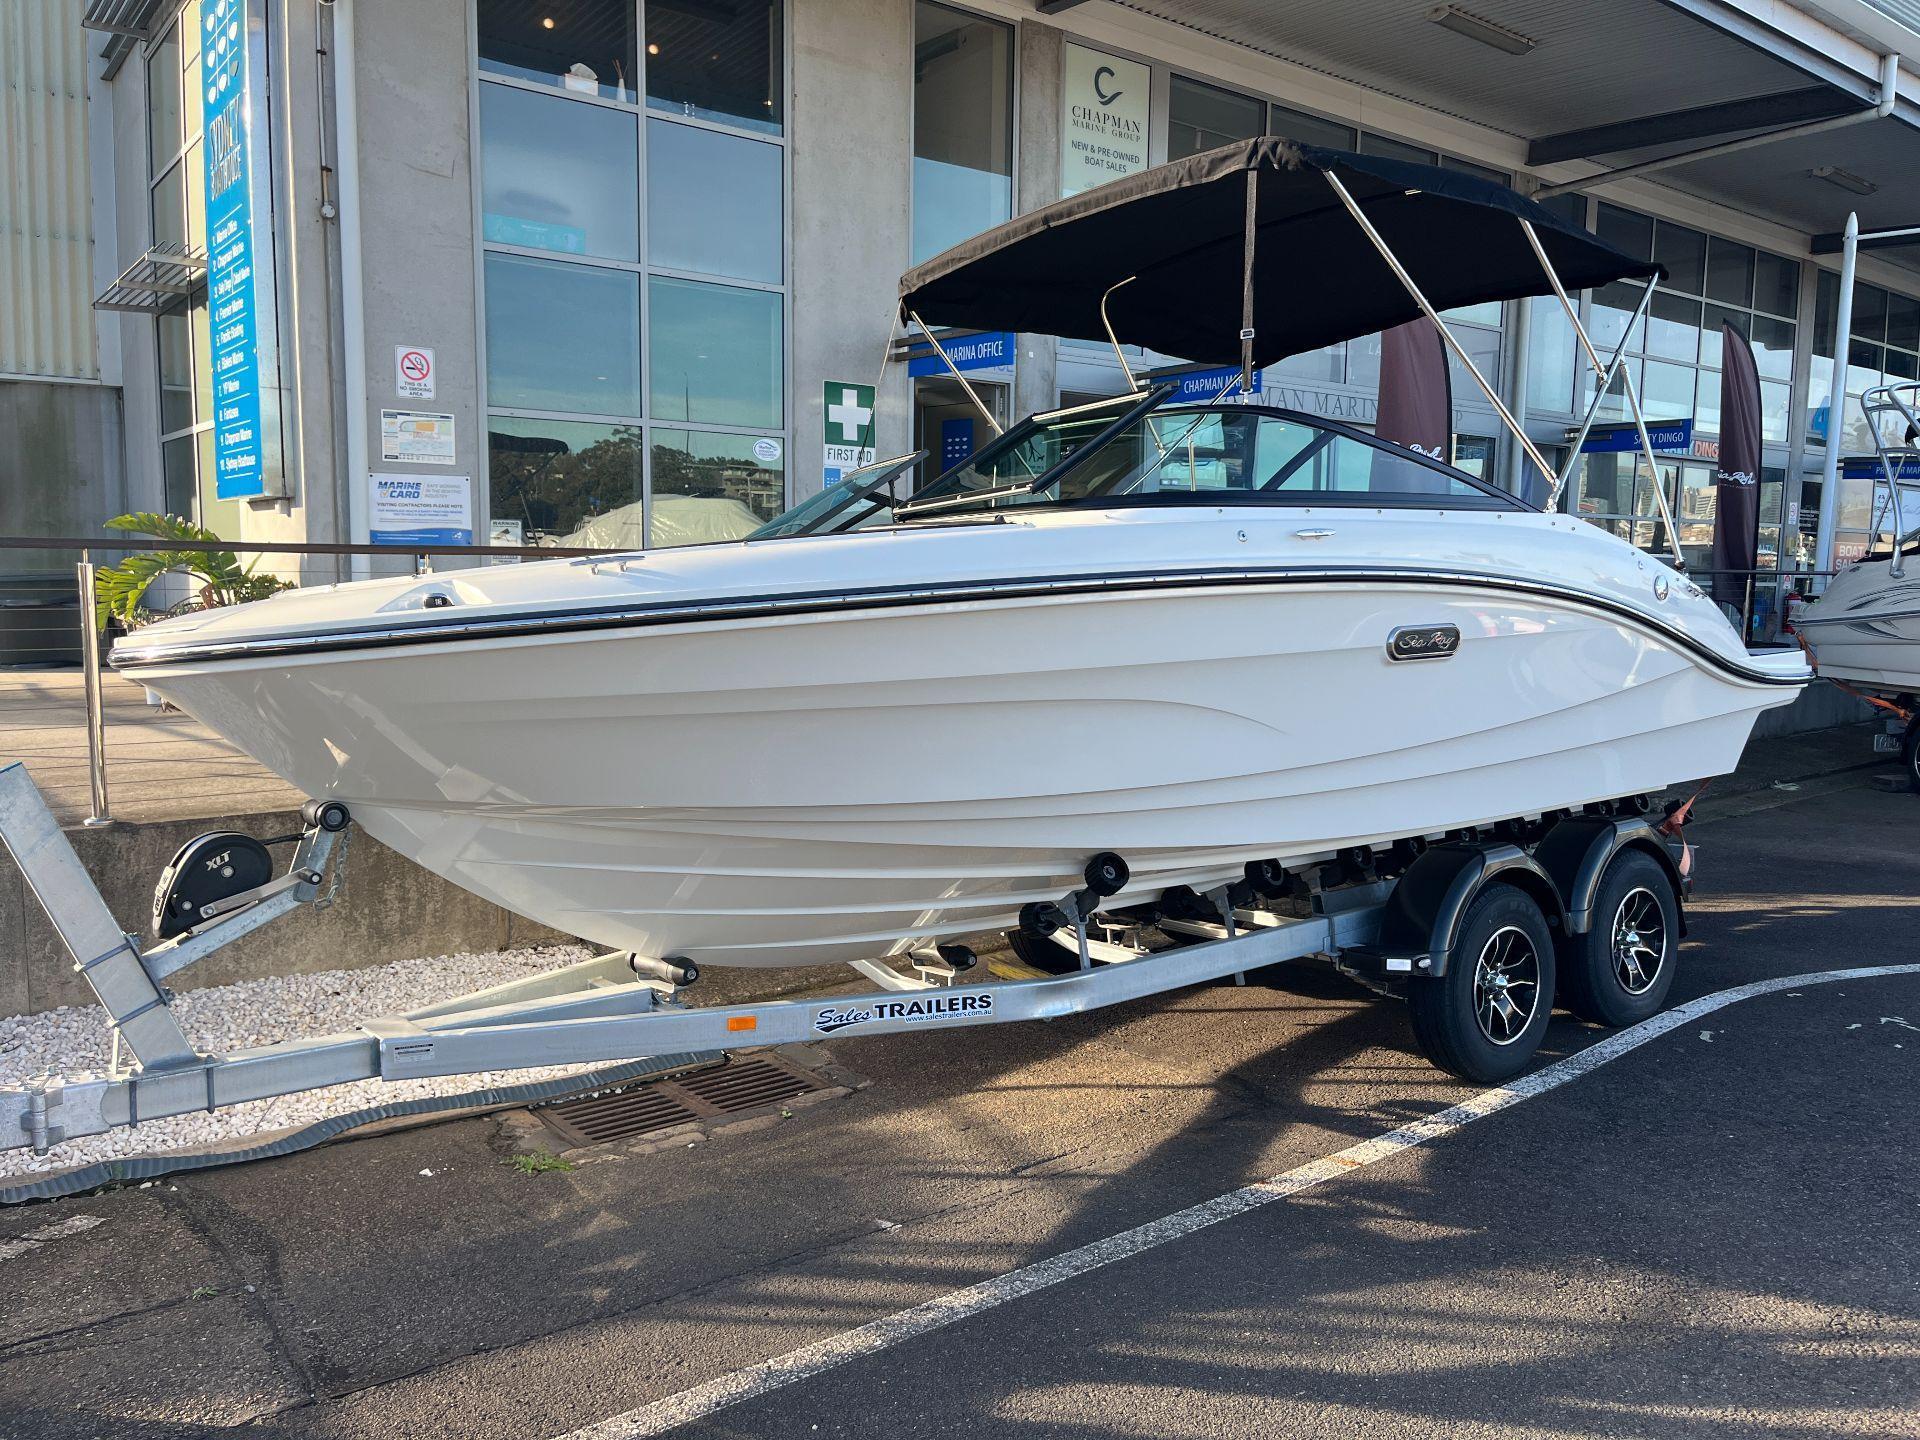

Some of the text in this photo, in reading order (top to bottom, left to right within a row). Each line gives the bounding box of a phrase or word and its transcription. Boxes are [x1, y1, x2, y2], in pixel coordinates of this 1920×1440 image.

[1072, 105, 1141, 133] CHAPMAN
[210, 93, 241, 170] SYDNEY
[1072, 118, 1141, 143] MARINE GROUP
[1071, 140, 1140, 164] NEW & PRE-OWNED
[1084, 156, 1127, 173] BOAT SALES
[946, 340, 1003, 362] MARINA OFFICE
[1183, 375, 1223, 394] CHAPMAN
[1314, 391, 1378, 419] MARIN
[1634, 431, 1684, 445] STY DINGO
[827, 447, 872, 463] FIRST AID
[1693, 440, 1719, 459] DING
[377, 481, 422, 491] MARINE
[389, 490, 421, 499] CARD
[1839, 545, 1864, 558] BOAT
[1399, 631, 1456, 650] Sea Ray
[206, 850, 231, 871] XLT
[816, 994, 992, 1026] Sales TRAILERS
[904, 1008, 993, 1024] www.salestrailers.com.au
